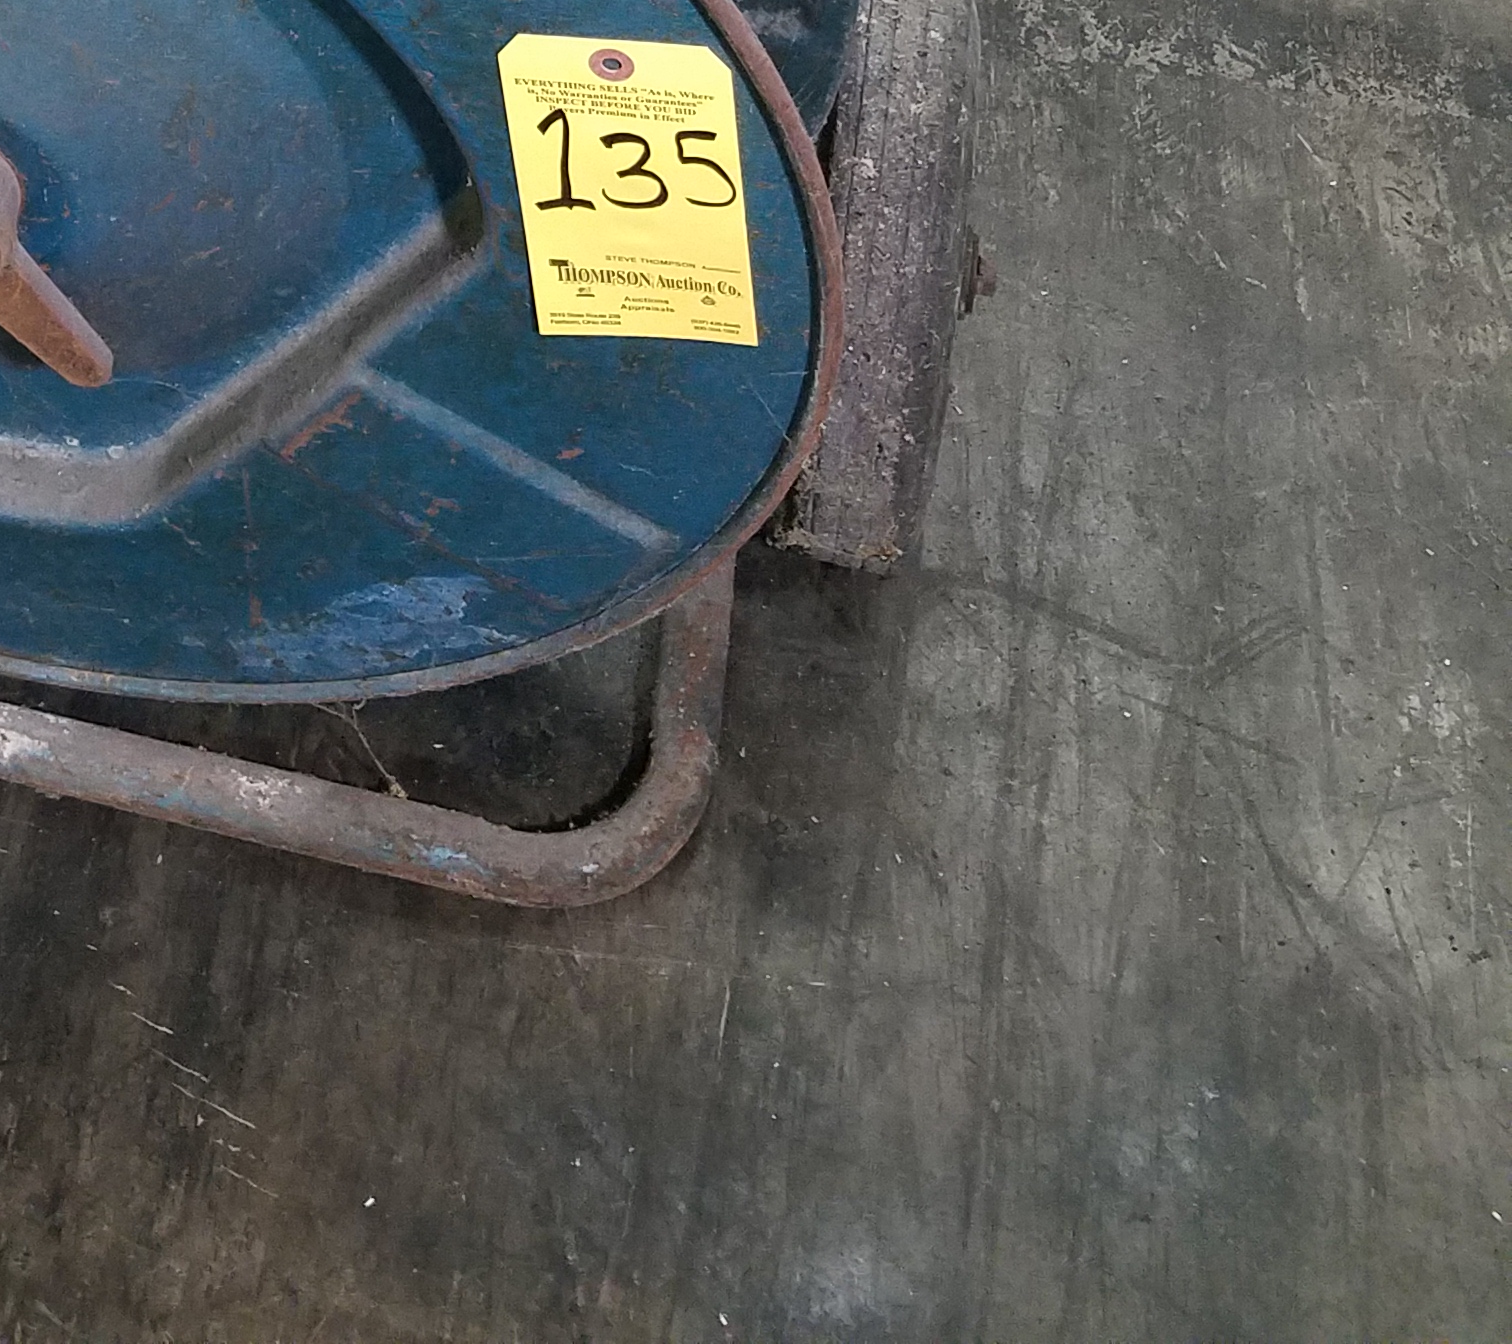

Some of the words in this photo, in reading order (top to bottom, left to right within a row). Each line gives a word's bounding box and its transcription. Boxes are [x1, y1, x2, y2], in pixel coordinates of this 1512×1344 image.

[514, 77, 596, 92] EVERYTHING
[599, 84, 638, 94] SELLS
[679, 90, 715, 101] Where
[541, 88, 556, 96] No
[558, 89, 618, 101] Warranties
[535, 95, 586, 107] INSPECT
[591, 100, 641, 111] BEFORE
[644, 104, 671, 114] YOU
[675, 107, 697, 116] BID
[588, 107, 637, 119] Premium
[639, 112, 650, 120] in
[653, 113, 685, 124] Effect
[535, 108, 737, 210] 135
[605, 254, 637, 263] STEVE
[641, 257, 696, 269] THOMPSON
[656, 273, 713, 293] Auction
